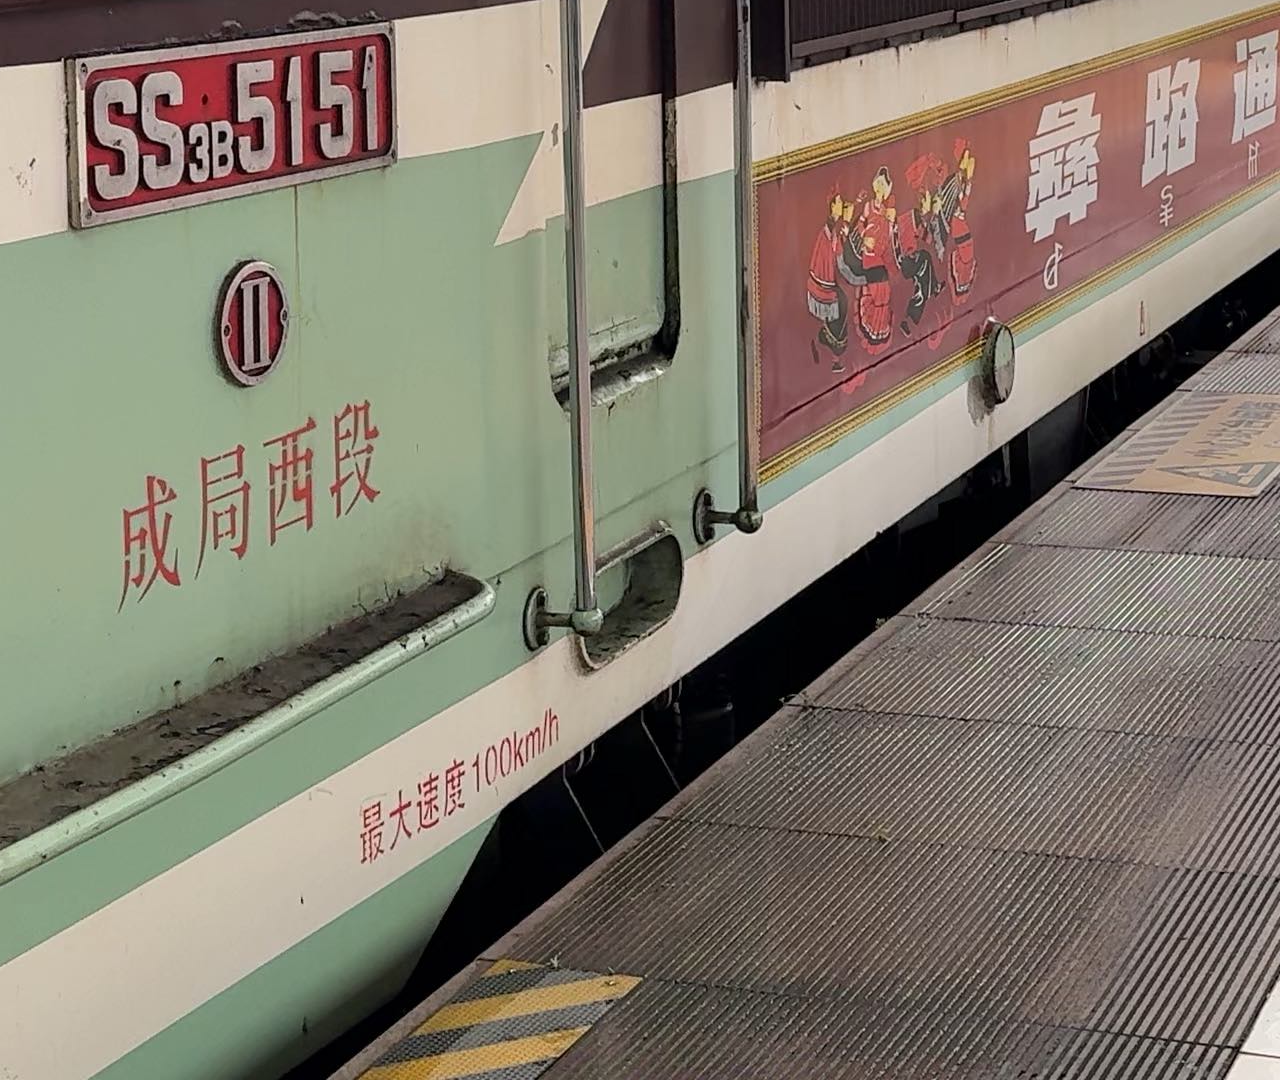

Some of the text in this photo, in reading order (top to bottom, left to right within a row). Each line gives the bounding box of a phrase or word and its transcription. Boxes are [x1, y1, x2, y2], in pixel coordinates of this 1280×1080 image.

[92, 45, 379, 200] SS3B5151
[118, 400, 380, 614] 成局西段
